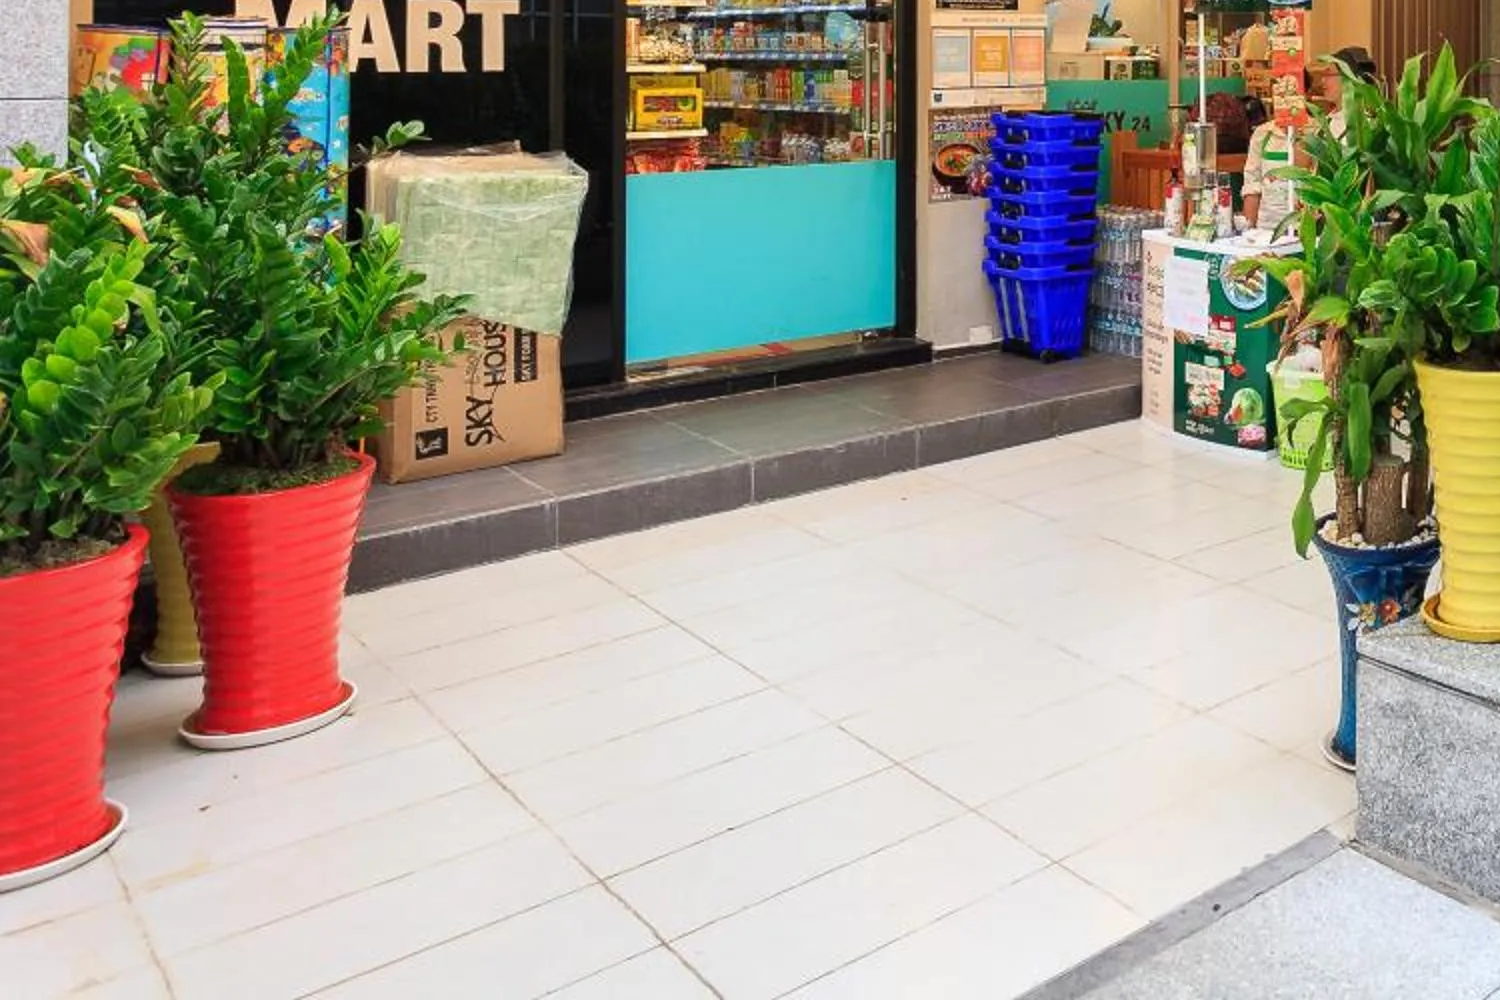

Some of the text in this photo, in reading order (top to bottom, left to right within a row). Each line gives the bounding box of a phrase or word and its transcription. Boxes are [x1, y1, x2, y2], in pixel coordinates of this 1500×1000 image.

[1103, 111, 1126, 134] KY
[465, 395, 493, 447] SKY
[483, 320, 507, 388] HOUS
